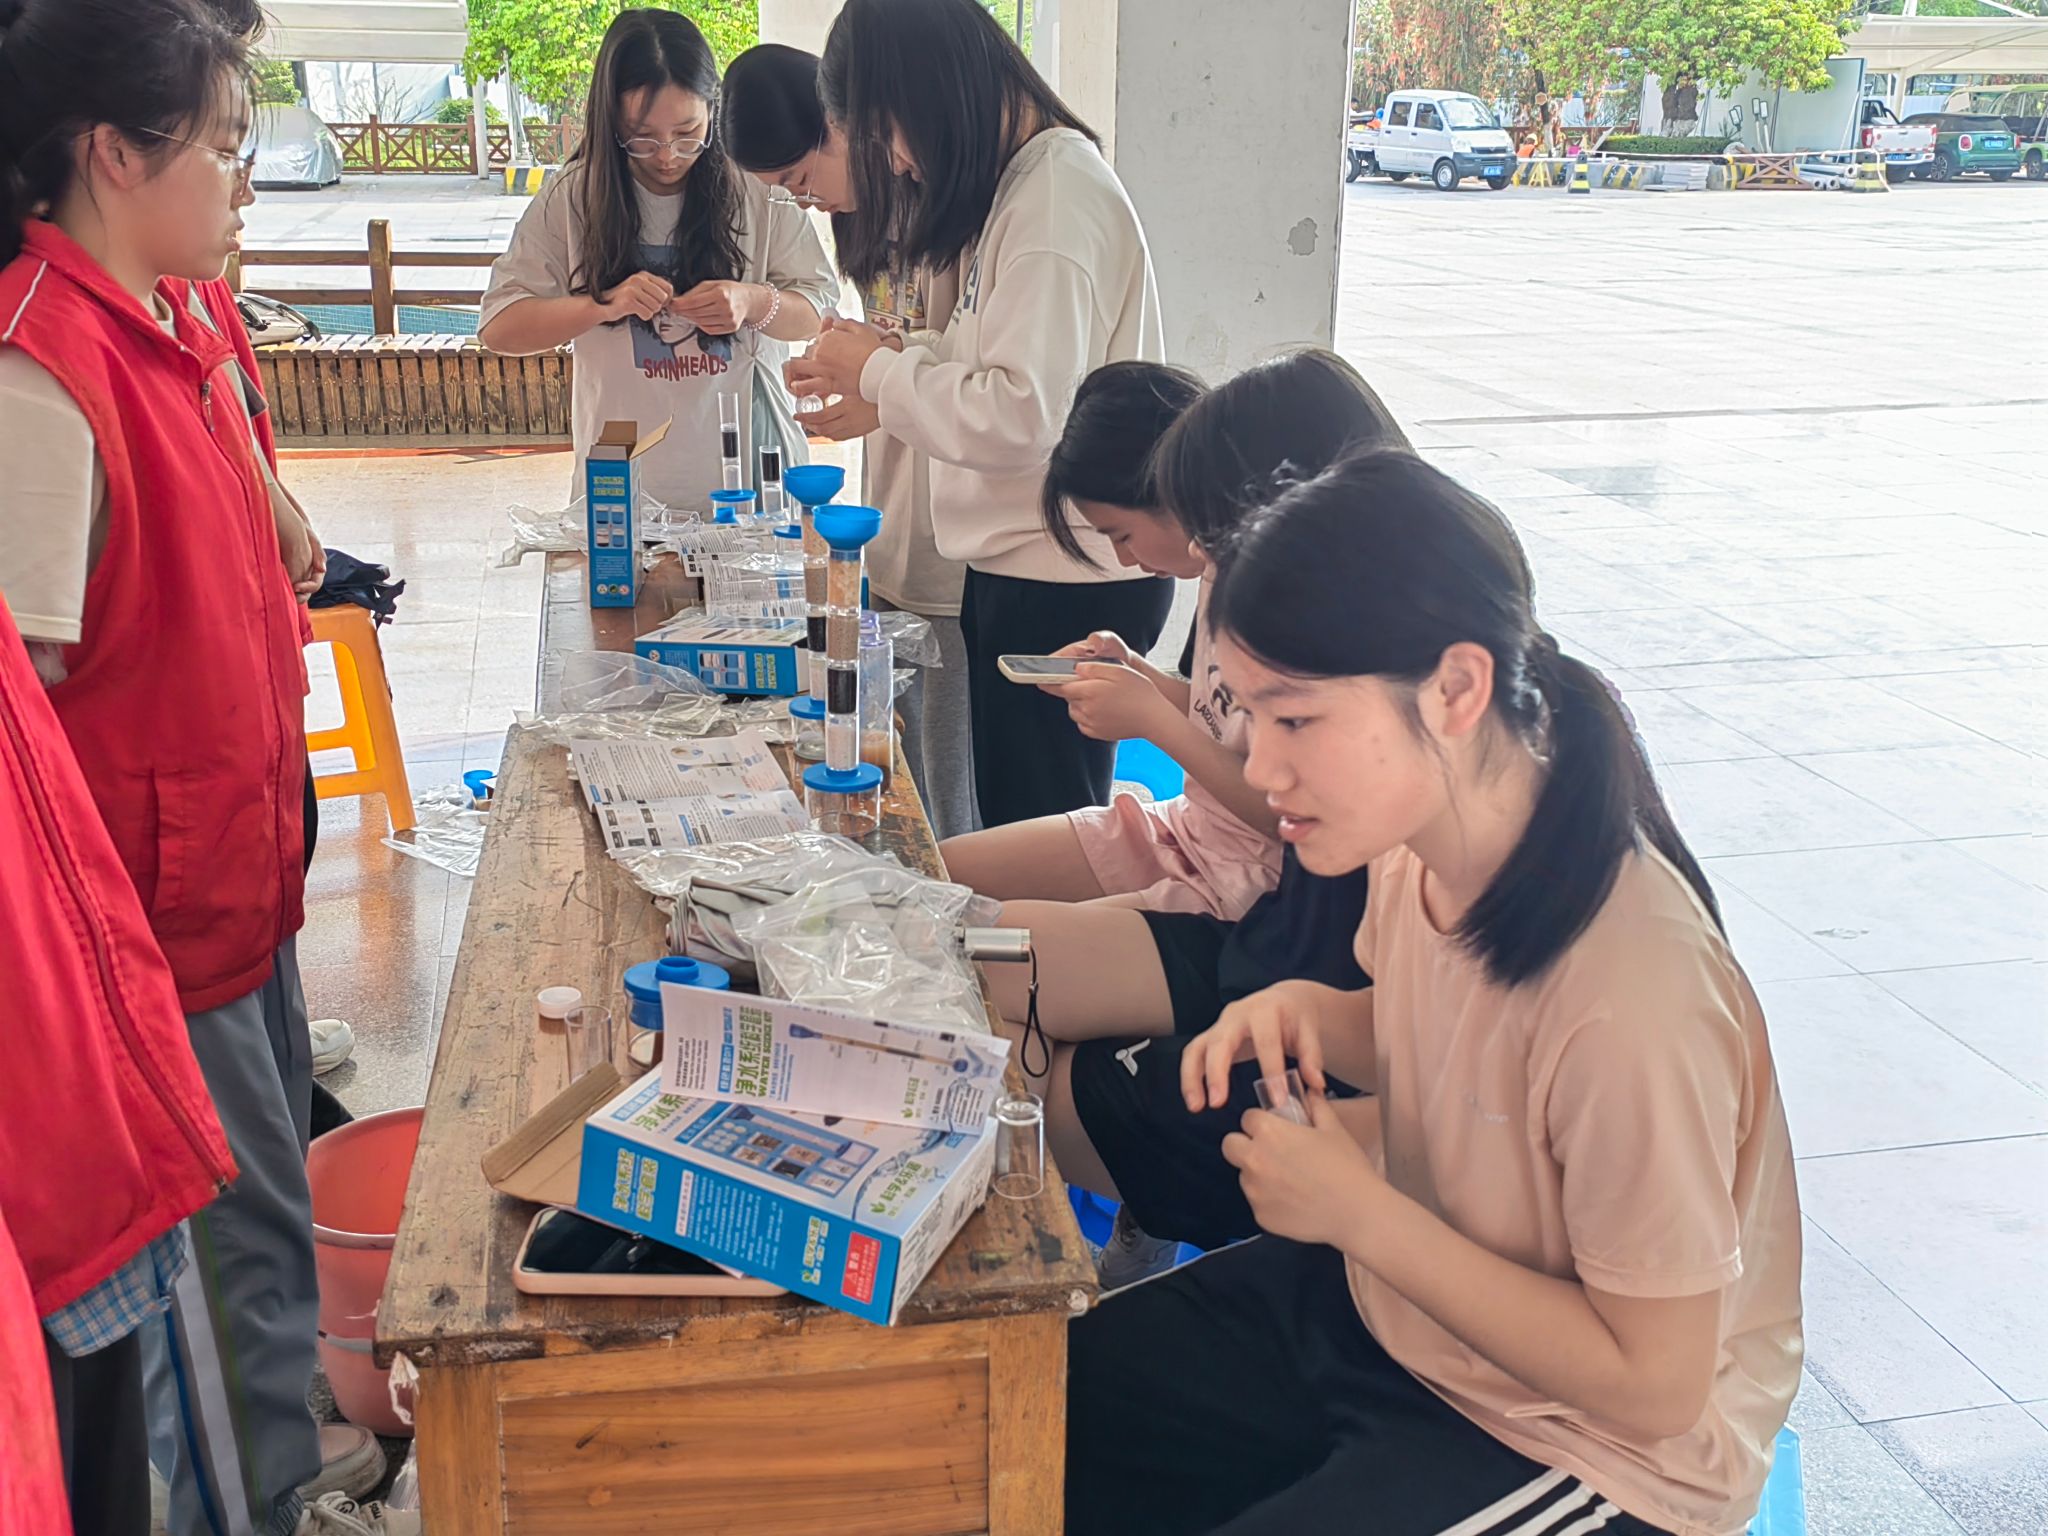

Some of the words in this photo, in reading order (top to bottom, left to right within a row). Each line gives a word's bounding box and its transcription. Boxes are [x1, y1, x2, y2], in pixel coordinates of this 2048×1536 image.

[643, 354, 728, 381] SKINHEADS
[735, 1005, 762, 1097] 净水系统科学套装
[763, 1023, 772, 1054] SCIENCE
[758, 1056, 771, 1097] WATER
[612, 1147, 636, 1213] 净水系统
